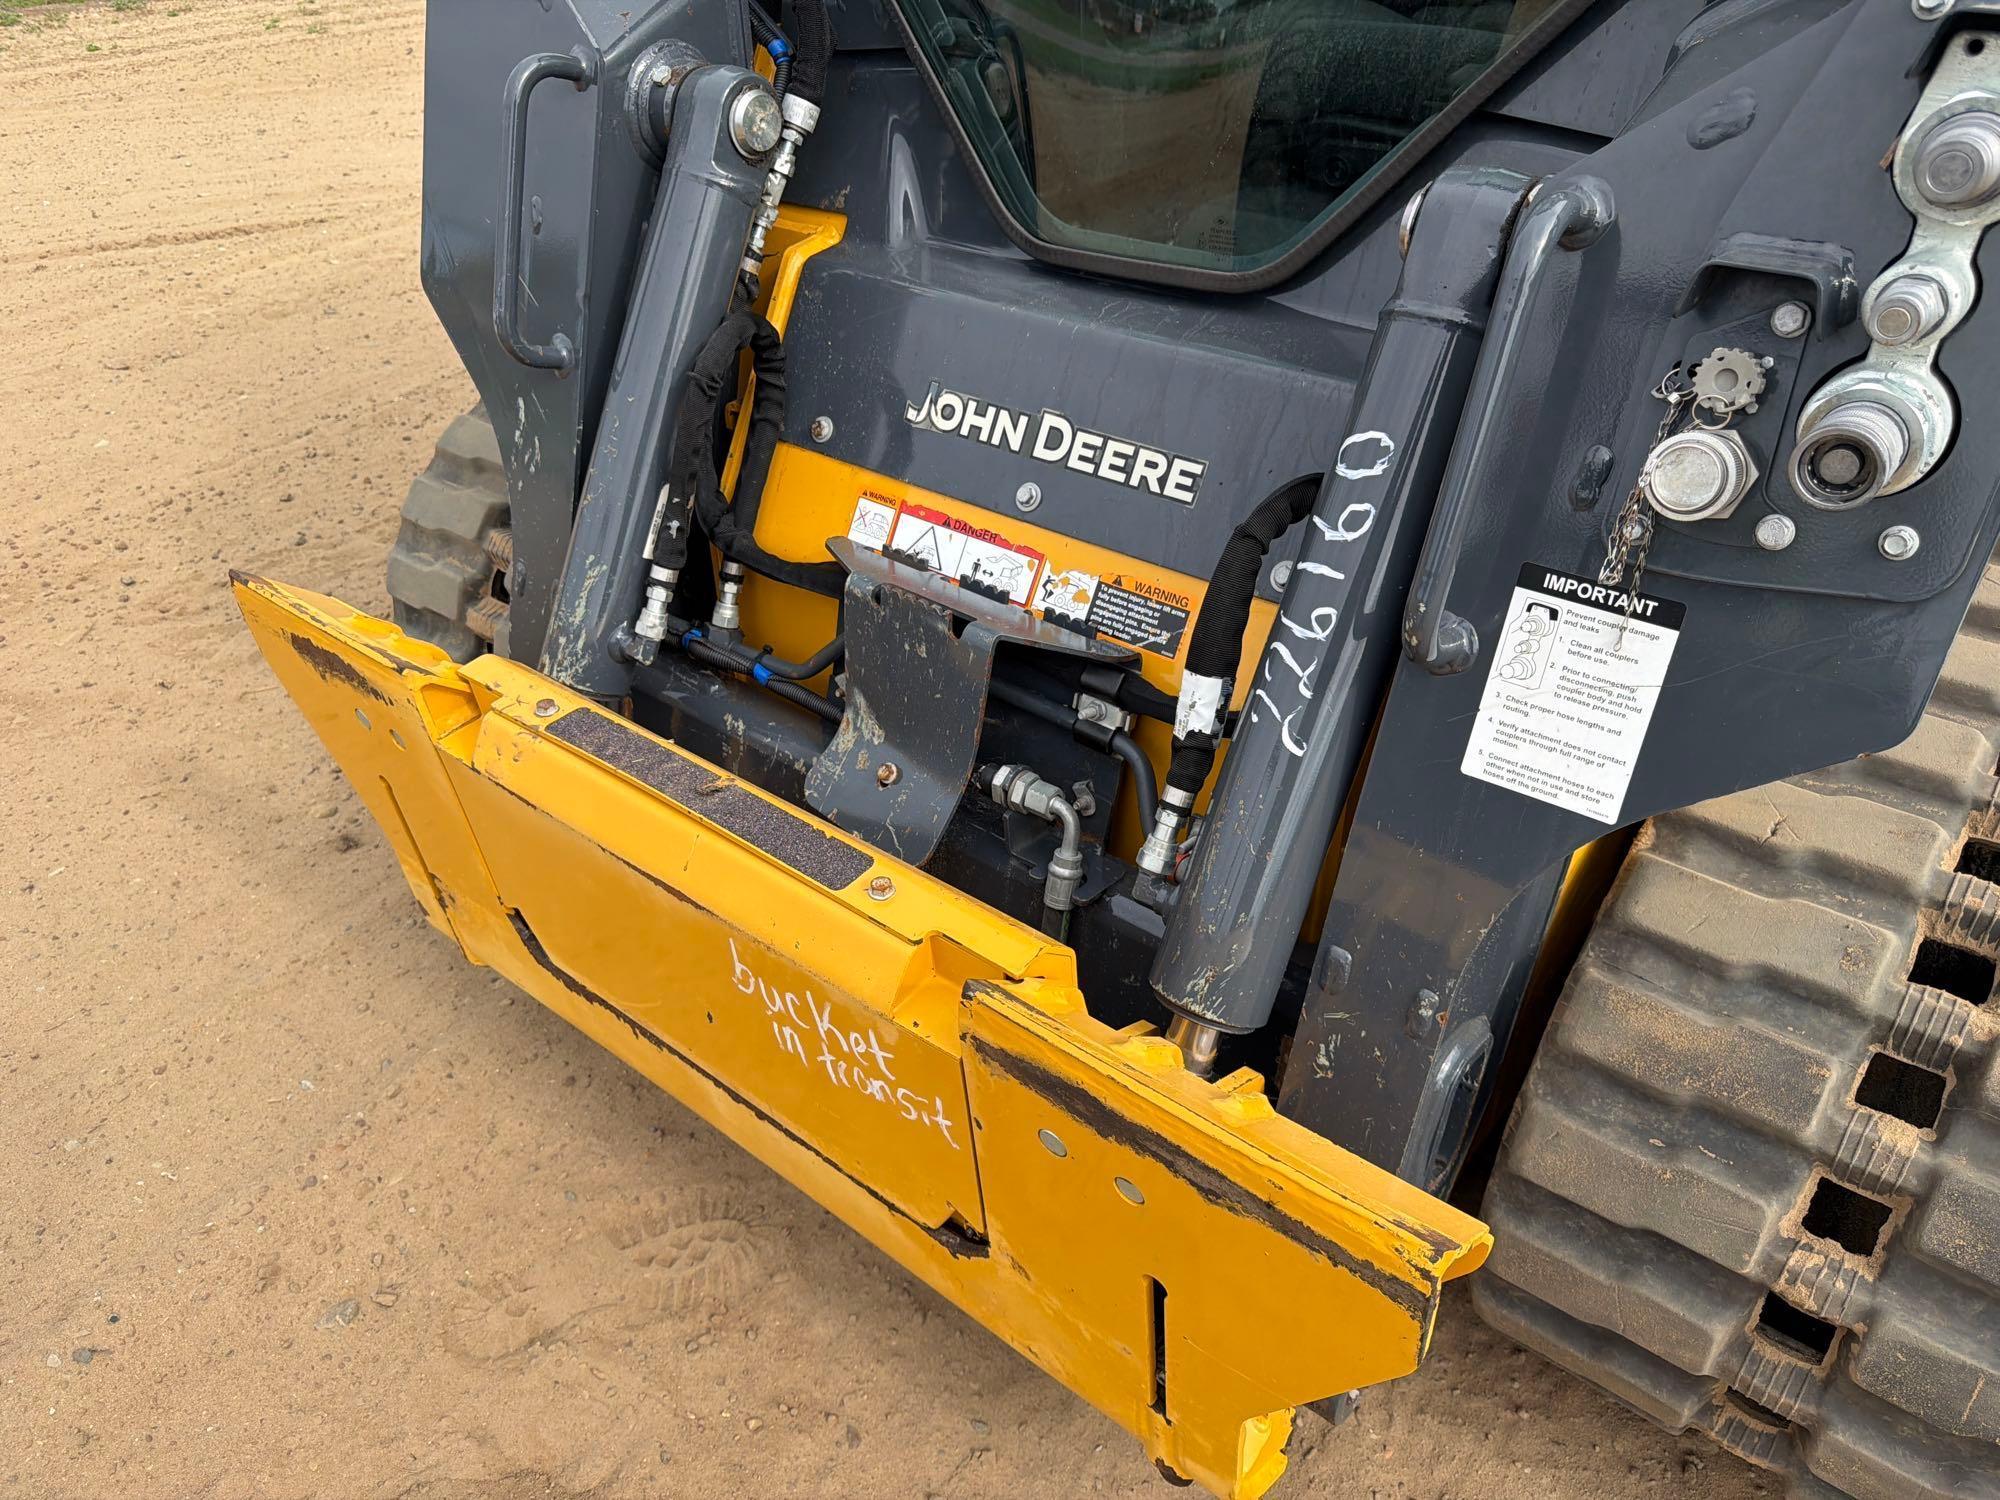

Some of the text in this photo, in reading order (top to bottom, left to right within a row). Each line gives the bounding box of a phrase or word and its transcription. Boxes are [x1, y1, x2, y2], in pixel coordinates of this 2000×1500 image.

[907, 381, 1206, 503] JOHN DEERE
[869, 491, 896, 506] WARNING
[954, 519, 998, 543] DANGER
[1098, 591, 1110, 601] fully
[1111, 596, 1127, 606] before
[1128, 602, 1153, 616] engaging
[1108, 586, 1128, 598] prevent
[1146, 600, 1162, 610] lower
[1163, 605, 1171, 613] lift
[1171, 609, 1186, 618] arms
[1134, 581, 1189, 608] WARNING
[1543, 573, 1659, 616] IMPORTANT
[1090, 615, 1102, 623] pins
[1113, 622, 1124, 631] fully
[1125, 626, 1148, 638] engaged
[1093, 608, 1125, 622] engagement
[1142, 624, 1160, 634] Ensure
[1096, 600, 1158, 625] disengaging attachment
[1566, 609, 1596, 622] Prevent
[1628, 627, 1660, 641] damage
[1563, 620, 1599, 634] and leaks
[1568, 648, 1592, 660] before
[1570, 639, 1592, 650] Clean
[1594, 646, 1603, 654] all
[1605, 650, 1639, 664] couplers
[1562, 665, 1581, 676] Prior
[1592, 676, 1638, 694] connecting/
[1503, 704, 1530, 718] routing.
[1556, 684, 1642, 714] coupler body and hold
[1564, 695, 1590, 707] release
[1592, 704, 1628, 720] pressure.
[1616, 692, 1636, 703] push
[1505, 695, 1528, 706] Check
[1530, 703, 1555, 716] proper
[1556, 712, 1575, 721] hose
[1576, 717, 1605, 731] lengths
[1606, 727, 1622, 736] and
[1496, 729, 1527, 743] couplers
[1529, 739, 1558, 753] through
[1559, 749, 1572, 757] full
[1573, 754, 1595, 765] range
[1498, 720, 1519, 732] Verify
[1520, 728, 1562, 745] attachment
[1563, 741, 1581, 751] does
[1583, 748, 1596, 756] not
[1597, 752, 1626, 767] contact
[1483, 768, 1504, 780] hoses
[1517, 780, 1530, 789] the
[1530, 786, 1559, 799] ground.
[1486, 761, 1505, 771] other
[1506, 768, 1526, 778] when
[1527, 775, 1540, 783] not
[1550, 783, 1563, 792] use
[1565, 788, 1579, 797] and
[1581, 794, 1600, 804] store
[1488, 752, 1519, 768] Connect
[1520, 764, 1561, 781] attachment
[1562, 777, 1585, 790] hoses
[1596, 790, 1615, 800] each
[773, 1021, 960, 1150] in transit
